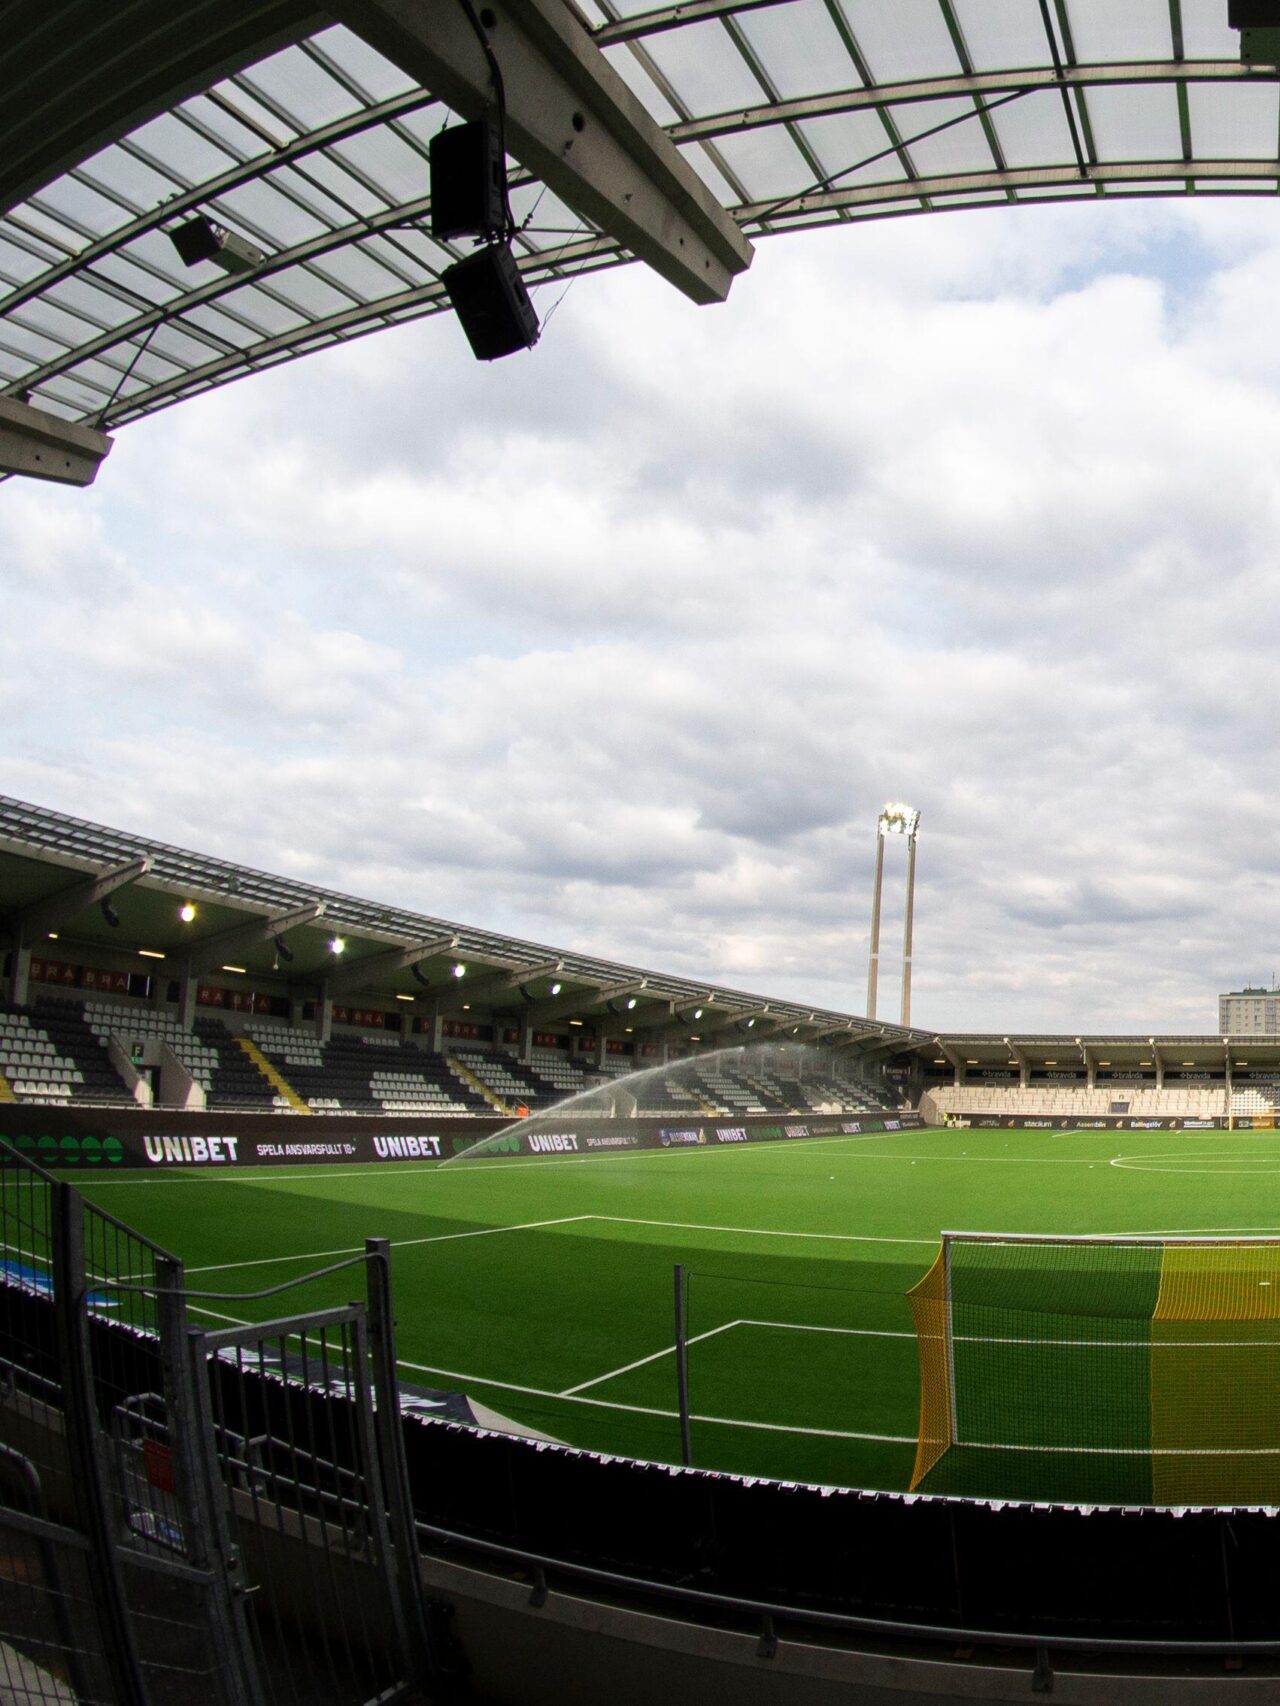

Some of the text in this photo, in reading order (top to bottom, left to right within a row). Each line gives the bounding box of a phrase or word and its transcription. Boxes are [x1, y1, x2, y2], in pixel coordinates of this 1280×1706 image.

[528, 1134, 578, 1152] UNIBET
[716, 1128, 747, 1142] UNIBET
[143, 1136, 238, 1161] UNIBET
[256, 1143, 356, 1156] SPELA ANSVARSFULLT 18+
[373, 1136, 441, 1158] UNIBET
